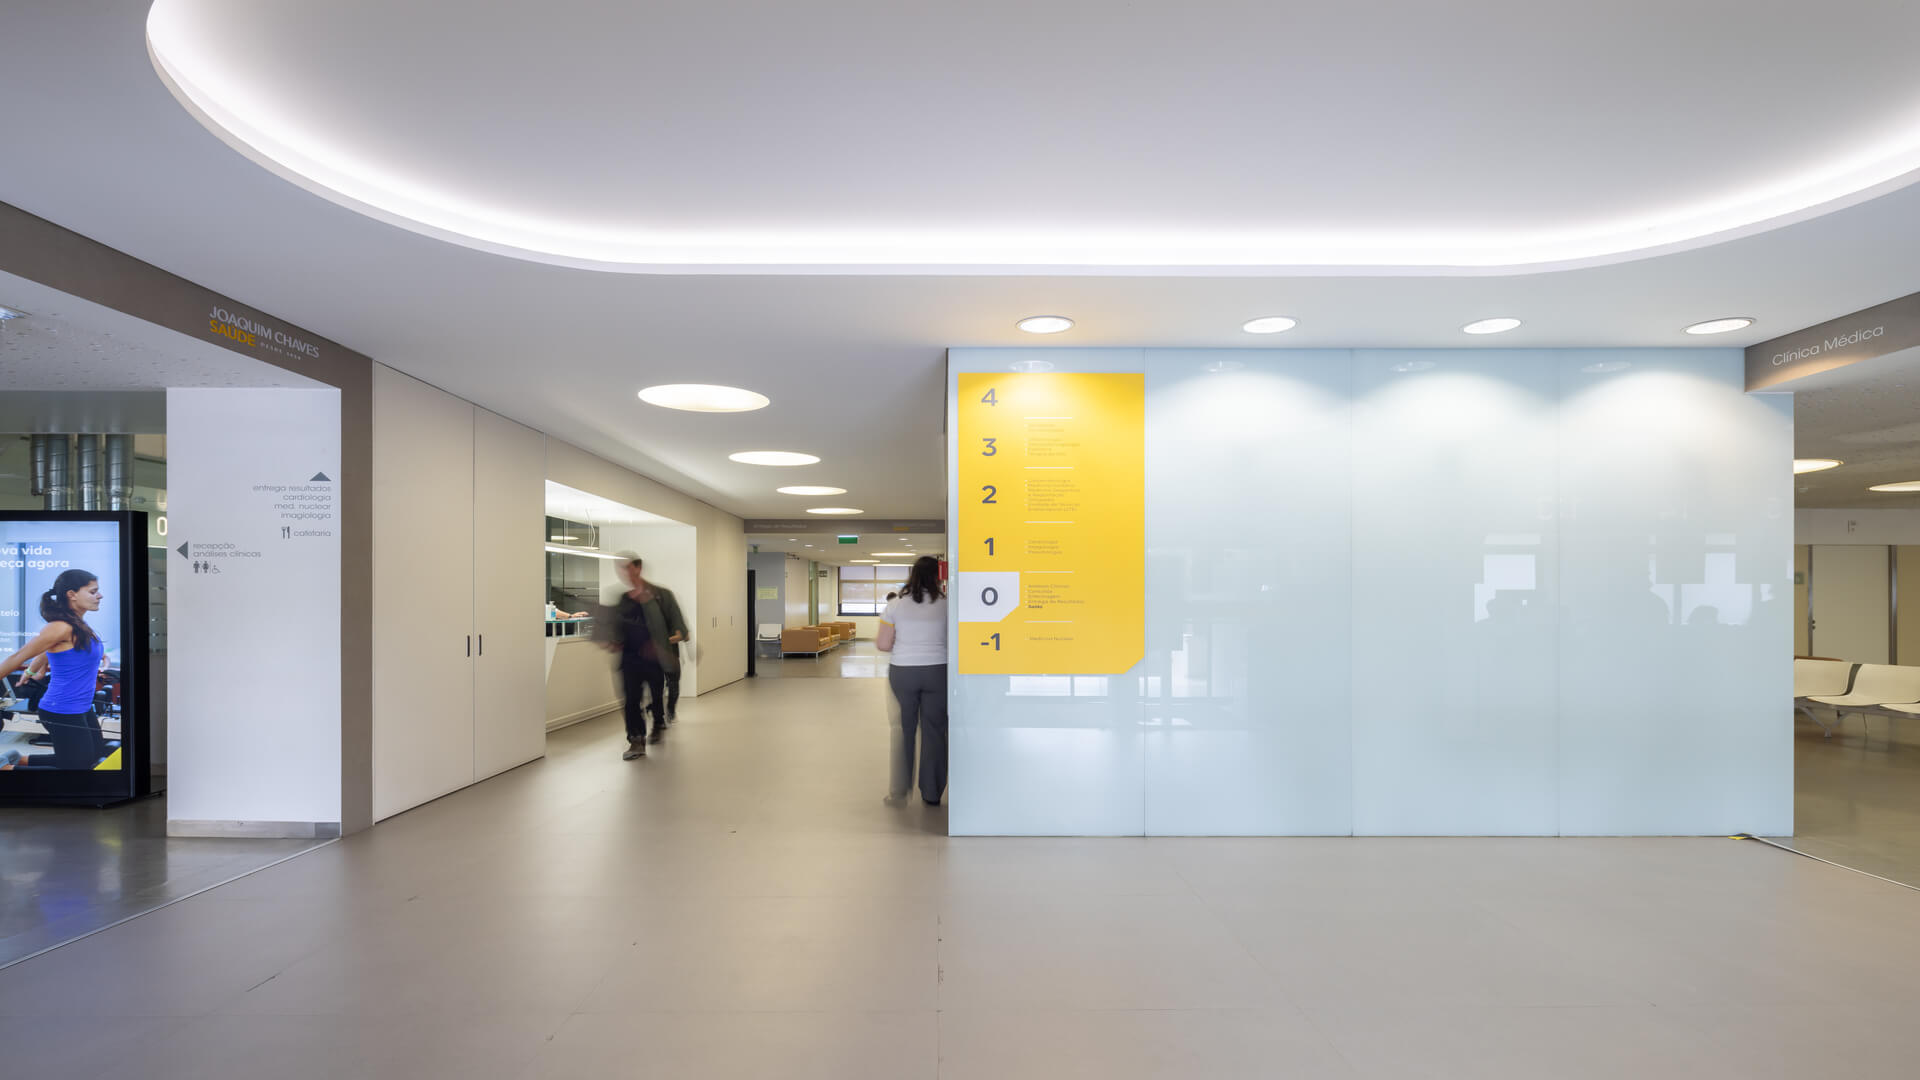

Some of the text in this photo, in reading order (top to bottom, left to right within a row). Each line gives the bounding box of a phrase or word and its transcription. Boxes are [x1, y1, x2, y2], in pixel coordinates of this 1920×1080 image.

[209, 305, 272, 340] JOAQUIM
[274, 331, 320, 358] CHAVES
[209, 319, 257, 347] SAÚDE
[1772, 326, 1885, 366] Clínica Médica
[981, 388, 998, 406] 4
[981, 438, 997, 456] 3
[252, 485, 287, 493] entrega
[282, 494, 332, 502] cardiologia
[981, 485, 997, 504] 2
[280, 513, 332, 521] imagiologia
[0, 545, 52, 556] va vida
[193, 542, 236, 551] recepção
[193, 550, 262, 558] análises clínicas
[984, 537, 995, 556] 1
[27, 560, 70, 570] agora
[981, 587, 998, 606] 0
[980, 633, 1001, 651] -1
